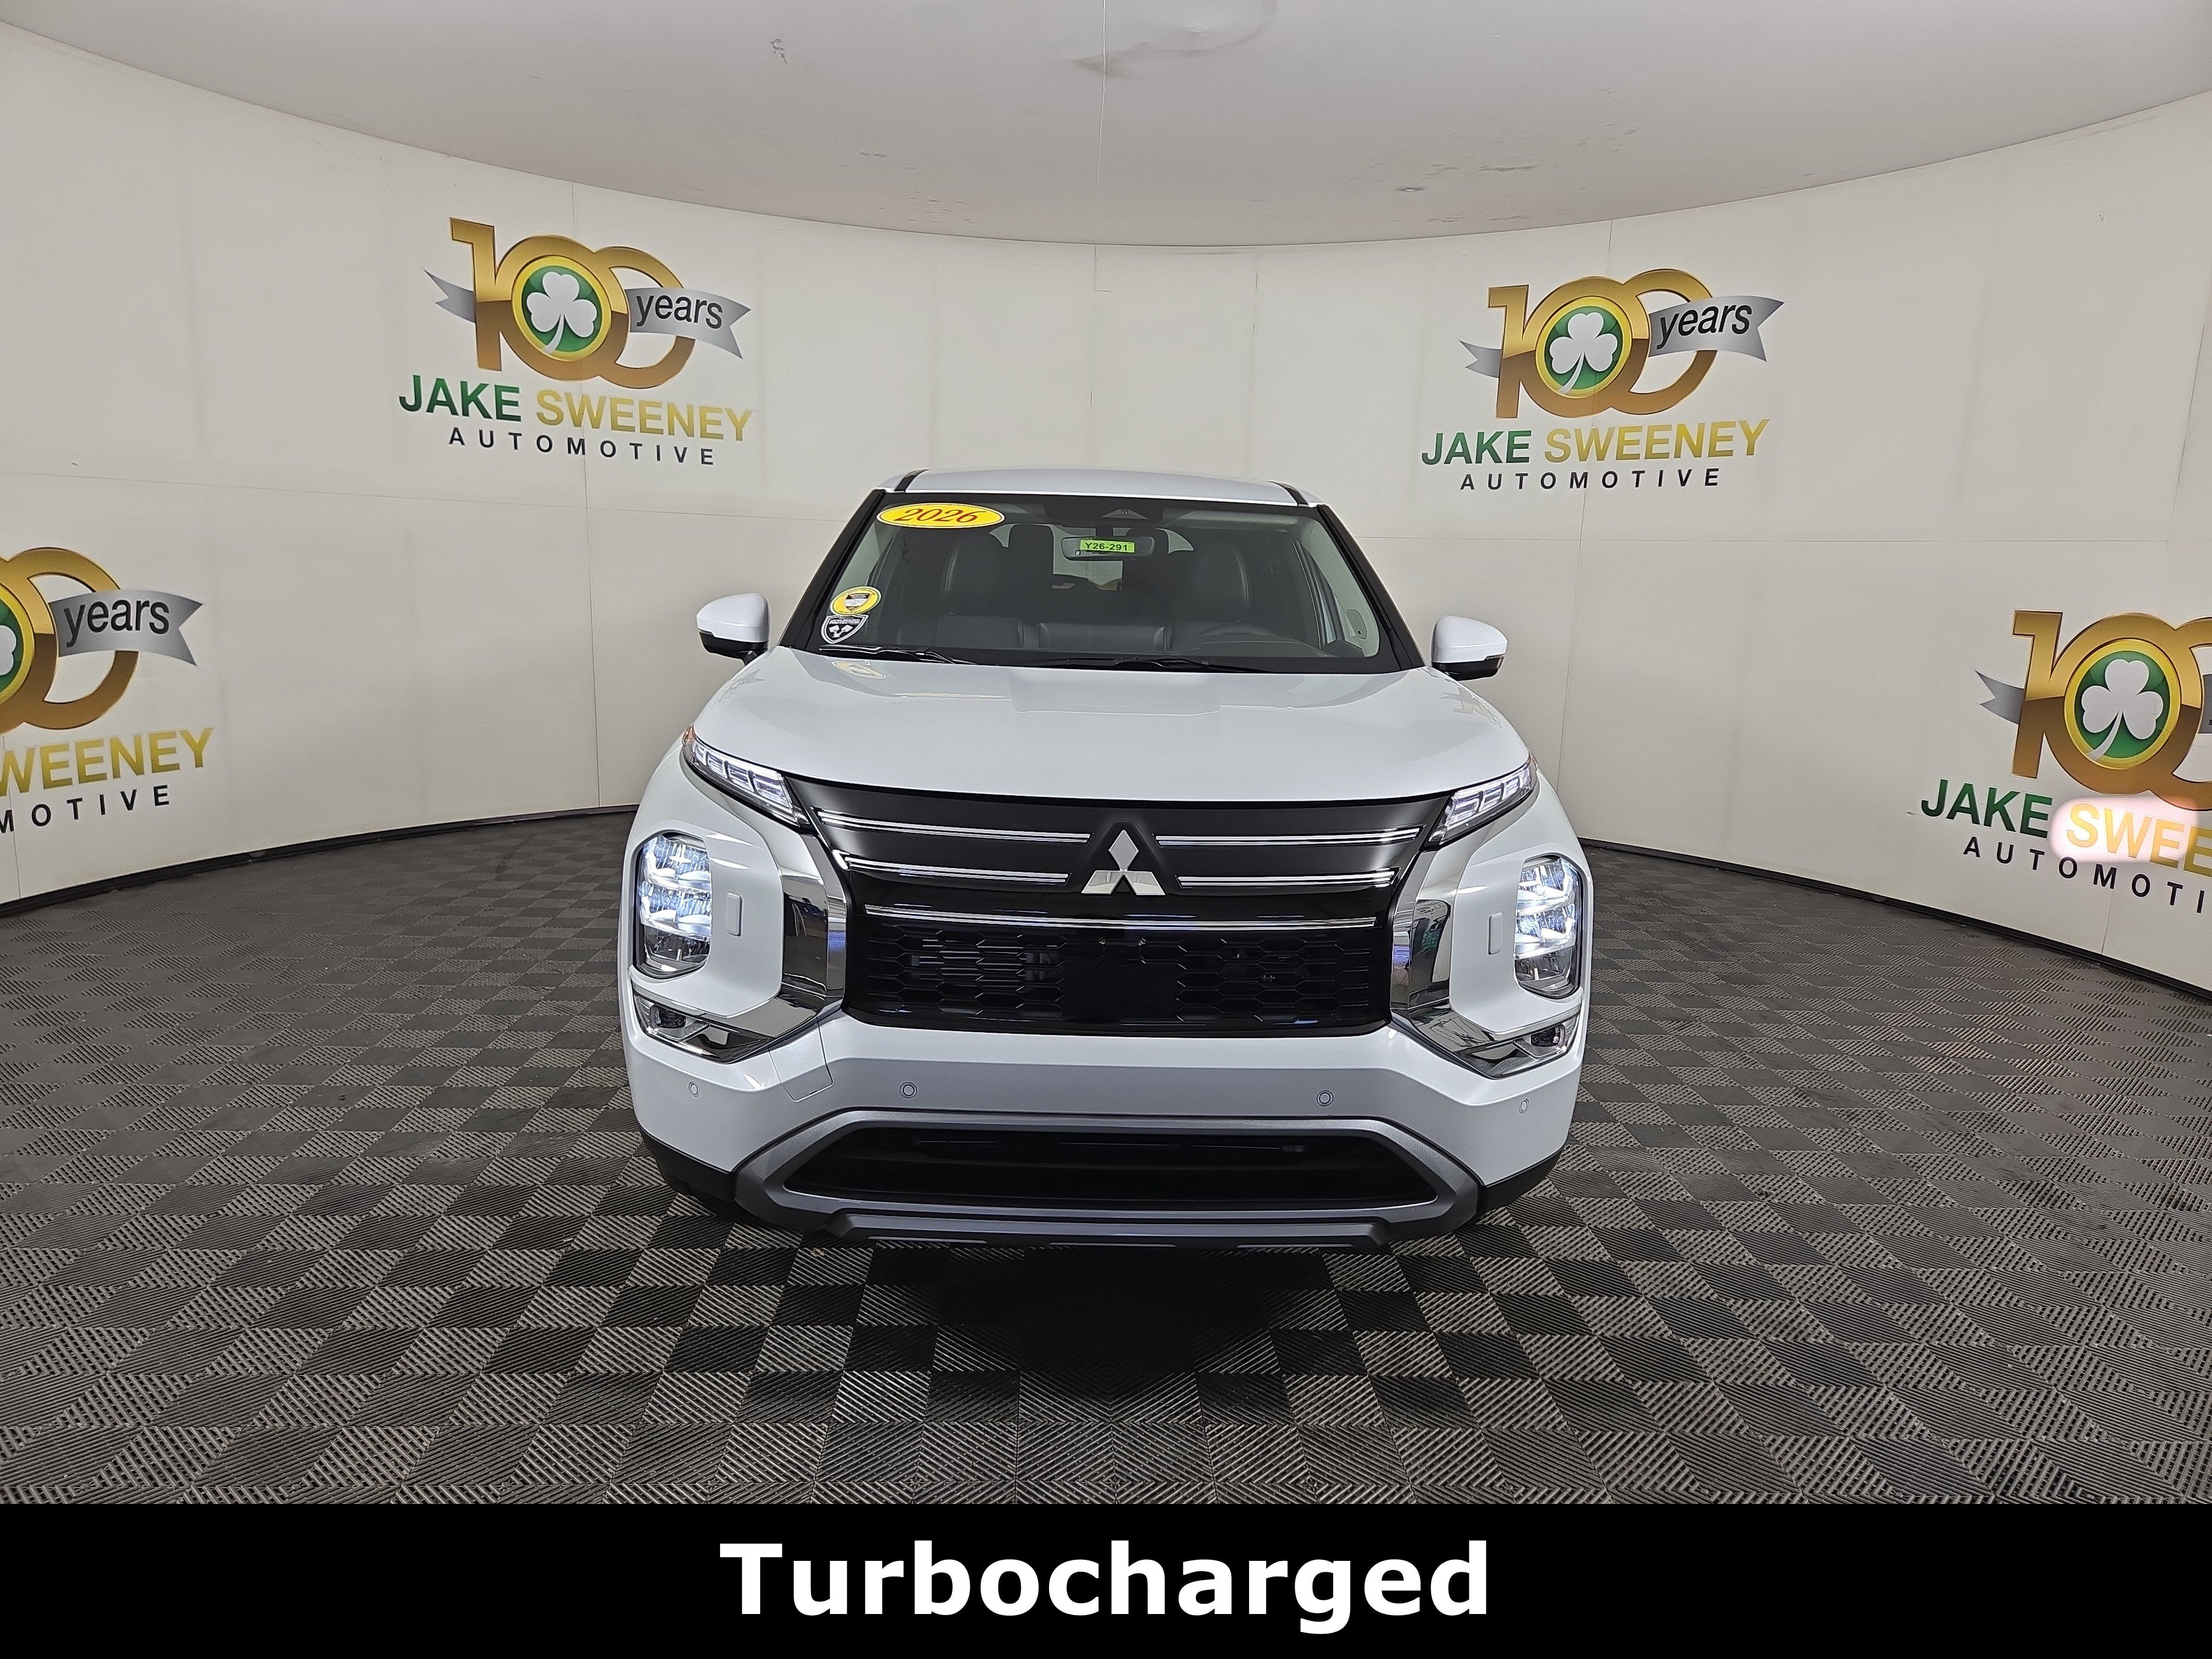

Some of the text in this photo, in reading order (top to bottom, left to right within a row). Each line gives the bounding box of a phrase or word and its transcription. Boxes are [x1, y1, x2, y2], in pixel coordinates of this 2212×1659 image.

[449, 217, 723, 390] 100 years
[1487, 268, 1752, 419] 100 years
[398, 375, 753, 442] JAKE SWEENEY
[449, 427, 714, 466] AUTOMOTIVE
[1421, 418, 1770, 465] JAKE SWEENEY
[1459, 467, 1720, 491] AUTOMOTIVE
[893, 509, 987, 523] 2026
[1084, 542, 1128, 551] Y26-291
[63, 599, 170, 649] years
[0, 727, 214, 797] WEENEY
[0, 785, 170, 834] MOTIVE
[1921, 779, 2212, 878] JAKE SWEE
[1963, 835, 2205, 914] AUTOMOTI
